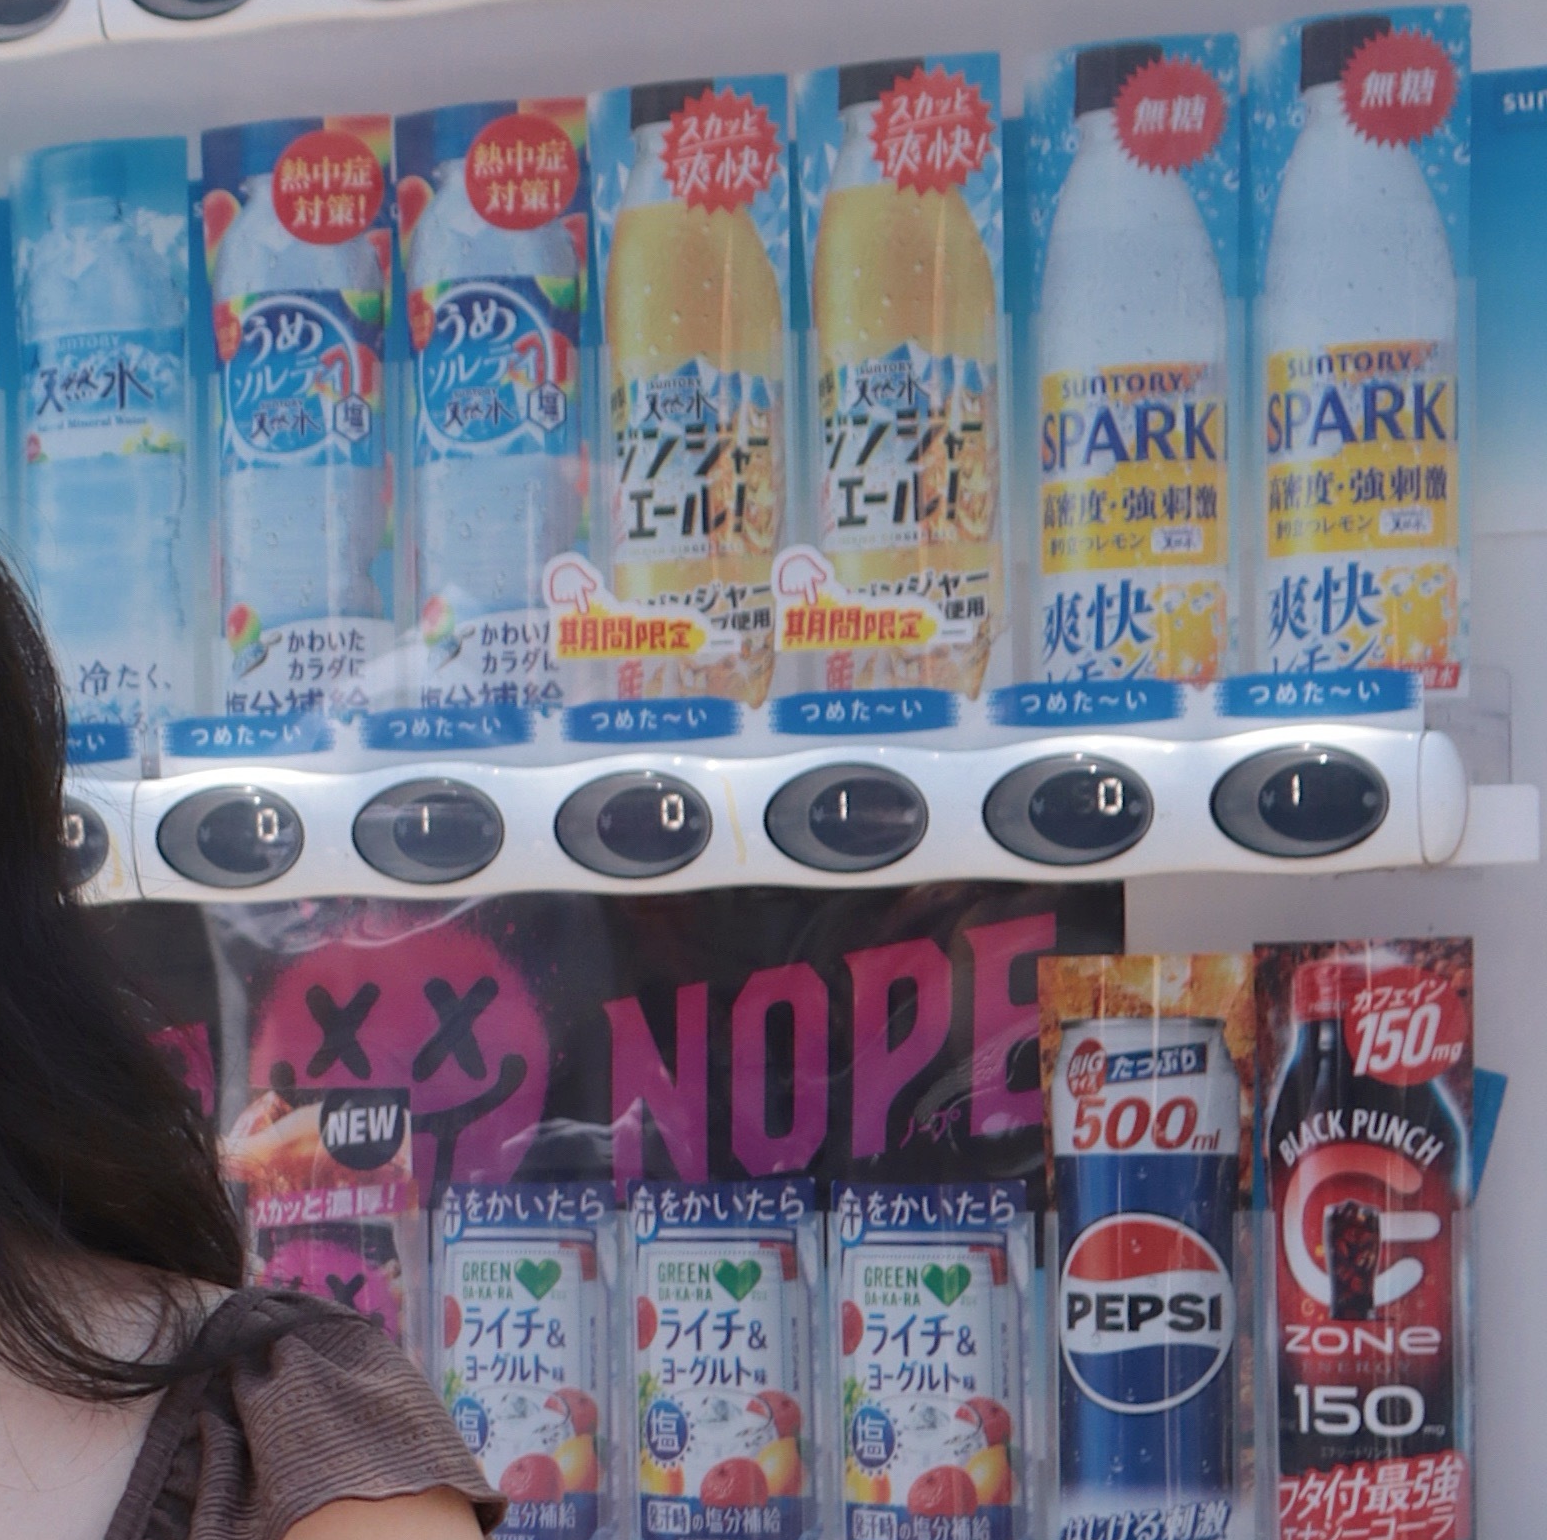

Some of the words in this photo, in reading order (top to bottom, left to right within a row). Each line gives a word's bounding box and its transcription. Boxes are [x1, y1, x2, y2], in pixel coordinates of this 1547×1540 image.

[888, 87, 970, 125] スカッと
[1360, 66, 1437, 108] 無糖
[678, 111, 758, 146] スカッと
[1133, 94, 1207, 135] 無糖
[280, 156, 373, 192] 熱中症
[473, 139, 568, 175] 熱中症
[293, 195, 368, 229] 対策!
[485, 178, 562, 213] 対策!
[244, 311, 322, 366] うめ
[438, 298, 517, 354] うめ
[1287, 348, 1413, 382] SUNTORY
[38, 359, 154, 417] 天然水
[1061, 371, 1183, 400] SUNTORY
[1041, 400, 1218, 472] SPARK
[1266, 380, 1449, 456] SPARK
[628, 482, 746, 540] エール!
[838, 469, 960, 528] エール!
[1043, 578, 1157, 659] 爽快
[1268, 562, 1385, 646] 爽快
[288, 628, 365, 654] かわいた
[559, 618, 693, 652] 期間限定
[786, 609, 924, 644] 期間限定
[1351, 979, 1448, 1012] カフェイン
[604, 913, 1057, 1185] NOPE
[1068, 1049, 1104, 1076] BIG
[1109, 1047, 1197, 1078] たっぷり
[326, 1104, 398, 1148] NEW
[1278, 1109, 1346, 1167] BLACK
[1351, 1108, 1444, 1166] PUNCH
[463, 1262, 511, 1282] GREEN
[658, 1263, 710, 1284] GREEN
[864, 1266, 918, 1287] GREEN
[465, 1307, 567, 1349] ライチ&
[660, 1308, 767, 1351] ライチ&
[1067, 1292, 1222, 1332] PEPSI
[866, 1314, 976, 1357] ライチ&
[1294, 1385, 1425, 1436] 150
